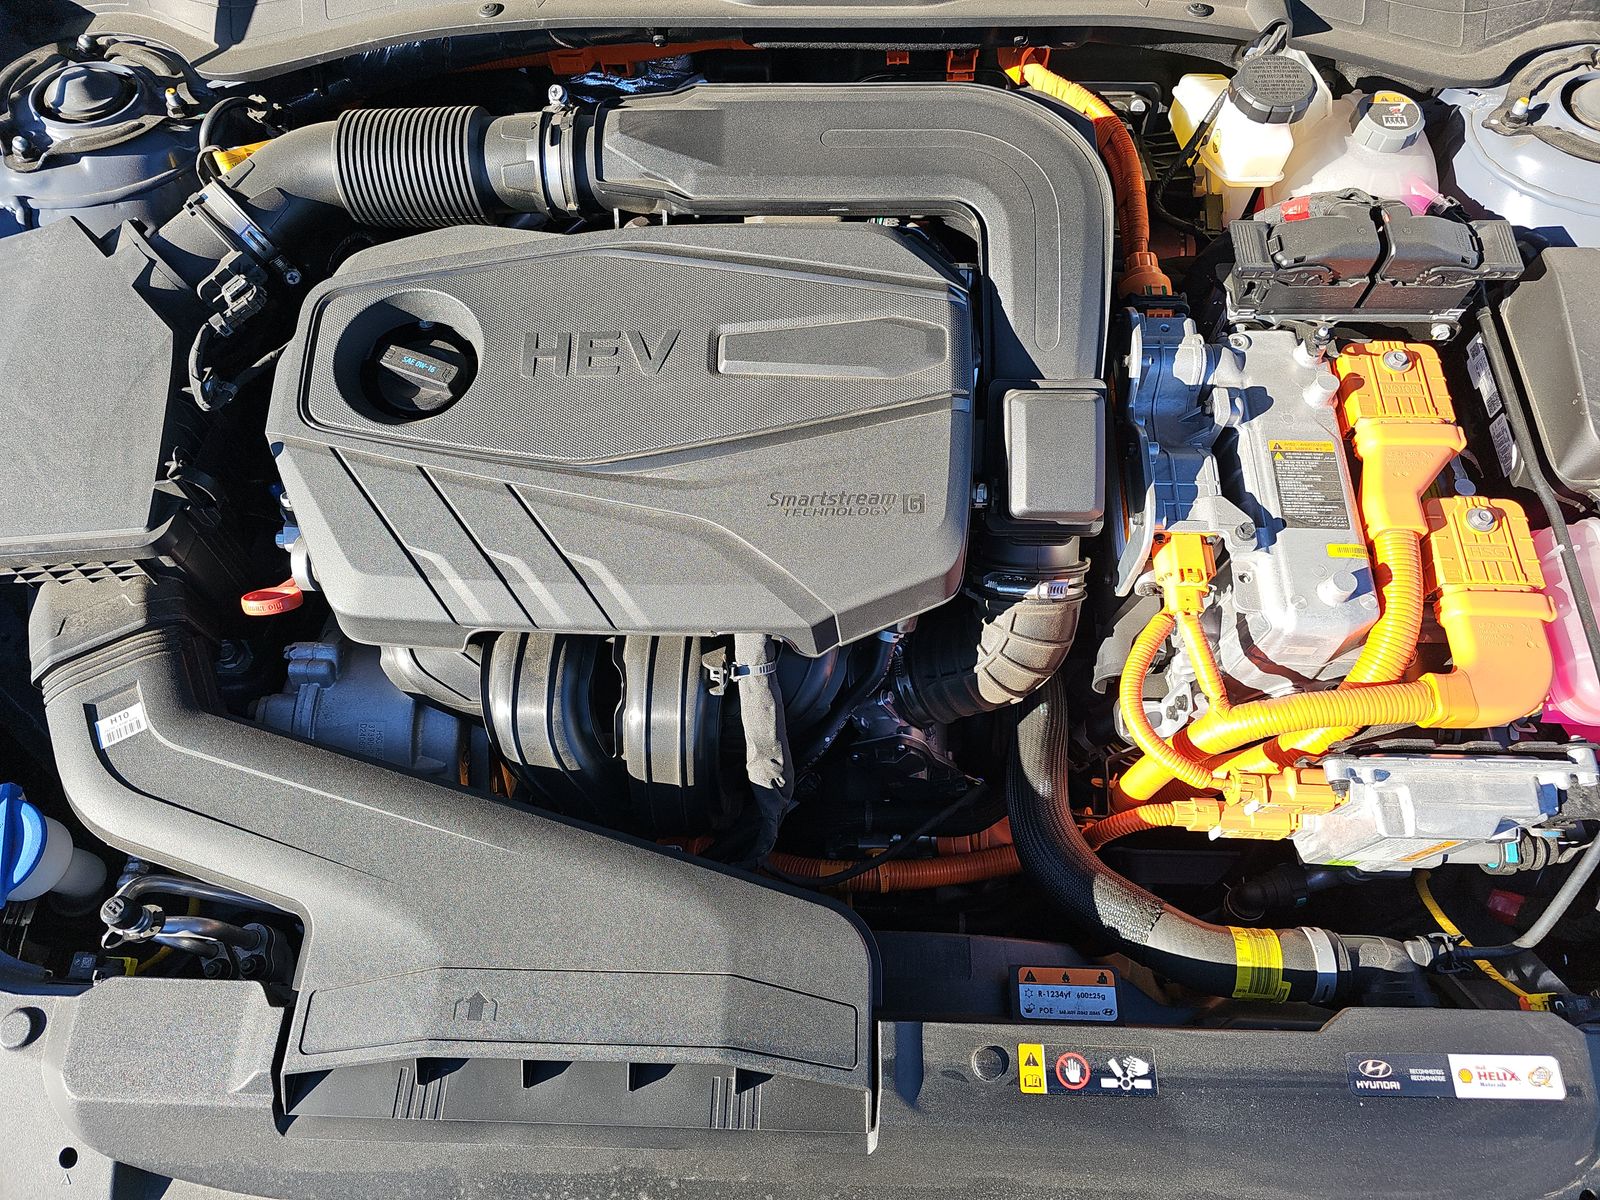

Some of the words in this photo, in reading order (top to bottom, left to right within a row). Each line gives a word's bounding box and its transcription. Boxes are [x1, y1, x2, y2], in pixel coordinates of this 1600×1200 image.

[520, 330, 681, 378] HEV
[402, 356, 415, 366] SAE
[415, 359, 437, 373] 0W-16
[1384, 384, 1421, 395] MOTOR
[767, 490, 898, 507] Smartstream
[782, 505, 894, 517] TECHNOLOGY
[1469, 546, 1506, 557] HSG
[110, 711, 130, 725] H10
[1038, 990, 1071, 1000] R-1234yf
[1076, 992, 1106, 1000] 600±25g
[1477, 1069, 1521, 1082] HELIX
[1356, 1080, 1401, 1090] HYUNDAI
